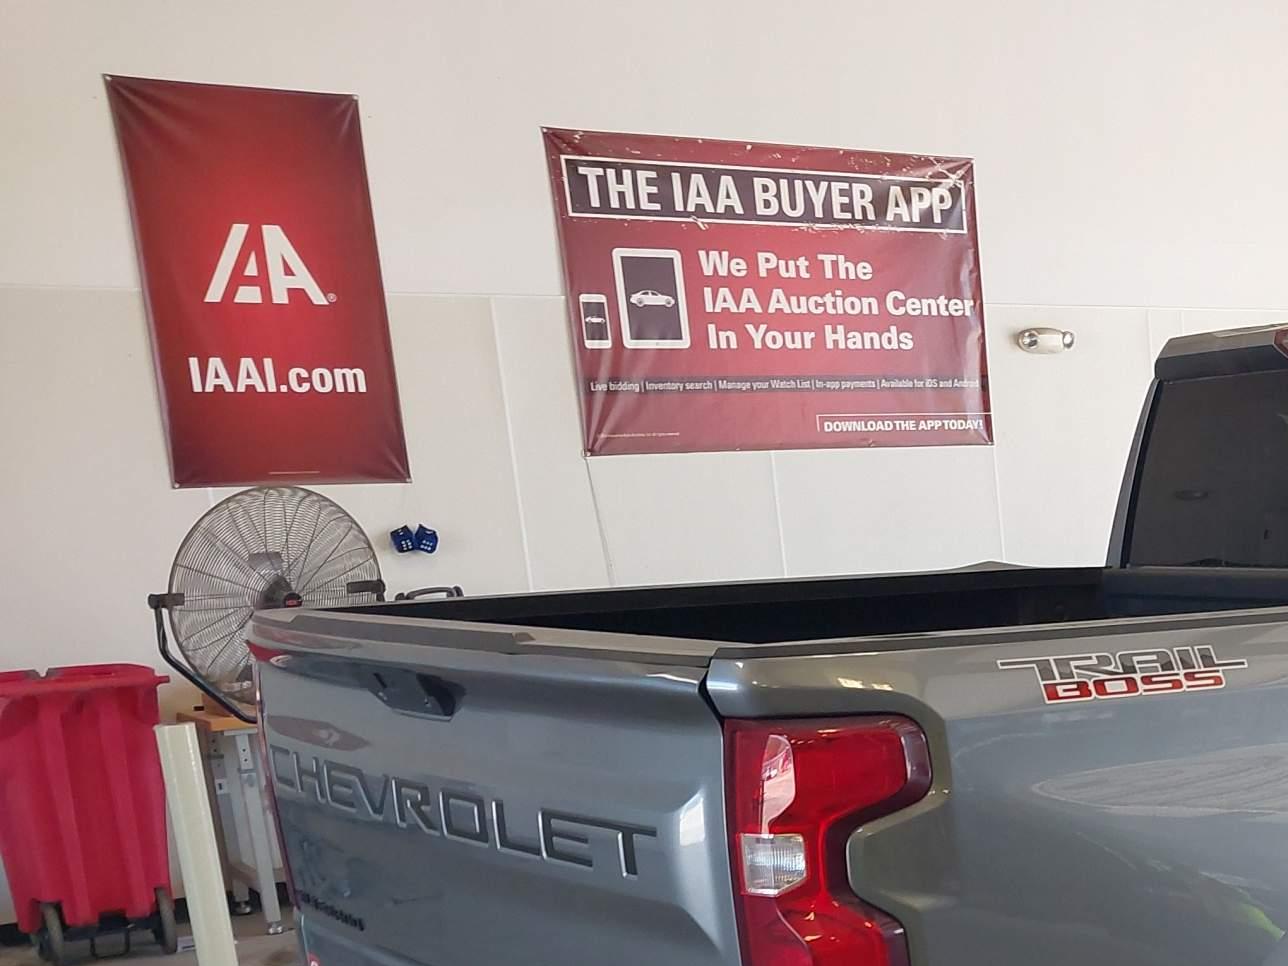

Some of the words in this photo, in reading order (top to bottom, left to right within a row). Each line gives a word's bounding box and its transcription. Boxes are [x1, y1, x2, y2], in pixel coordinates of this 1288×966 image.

[577, 166, 661, 211] THE
[670, 172, 745, 215] IAA
[752, 177, 876, 221] BUYER
[885, 185, 952, 224] APP
[698, 250, 748, 277] We
[757, 252, 811, 279] Put
[817, 254, 873, 280] The
[703, 287, 762, 313] IAA
[767, 288, 879, 315] Auction
[885, 290, 974, 317] Center
[707, 323, 738, 349] In
[745, 323, 816, 350] Your
[824, 324, 914, 350] Hands
[188, 356, 367, 393] IAAI.com
[590, 381, 607, 392] Live
[609, 381, 640, 393] bidding
[645, 380, 683, 392] Inventory
[684, 380, 713, 390] search
[718, 380, 751, 390] Manage
[752, 381, 769, 391] your
[769, 379, 796, 389] Watch
[796, 379, 811, 389] List
[815, 379, 840, 390] In-app
[840, 379, 876, 389] payments
[880, 378, 914, 389] Available
[913, 379, 925, 388] for
[939, 379, 953, 388] and
[824, 420, 893, 432] DOWNLOAD
[893, 420, 916, 431] THE
[918, 420, 942, 431] APP
[942, 419, 984, 431] TODAY!
[997, 644, 1248, 682] TRAIL
[1040, 669, 1226, 704] BOSS
[269, 743, 657, 880] CHEVROLET
